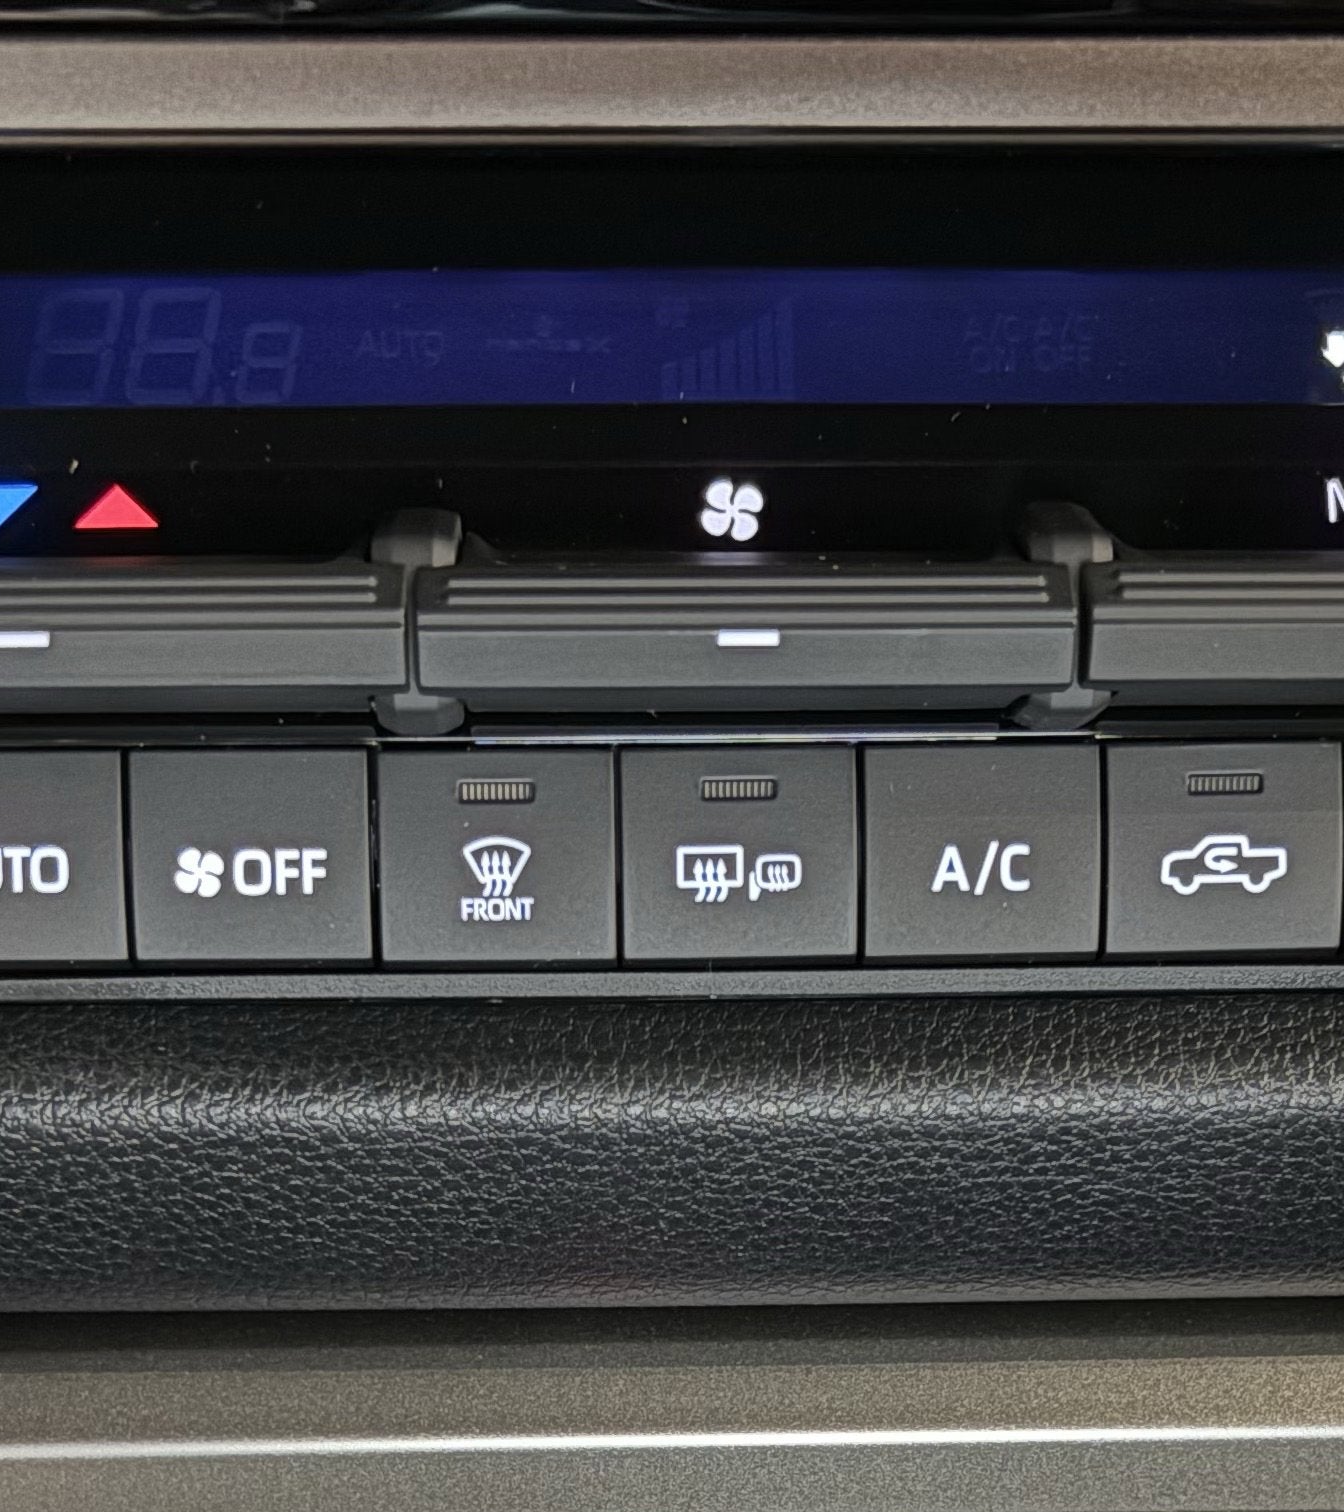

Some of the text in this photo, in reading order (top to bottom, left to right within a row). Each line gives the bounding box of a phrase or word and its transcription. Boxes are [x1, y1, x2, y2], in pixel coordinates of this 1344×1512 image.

[232, 848, 328, 897] OFF
[931, 840, 1032, 895] A/C
[458, 896, 535, 922] FRONT
